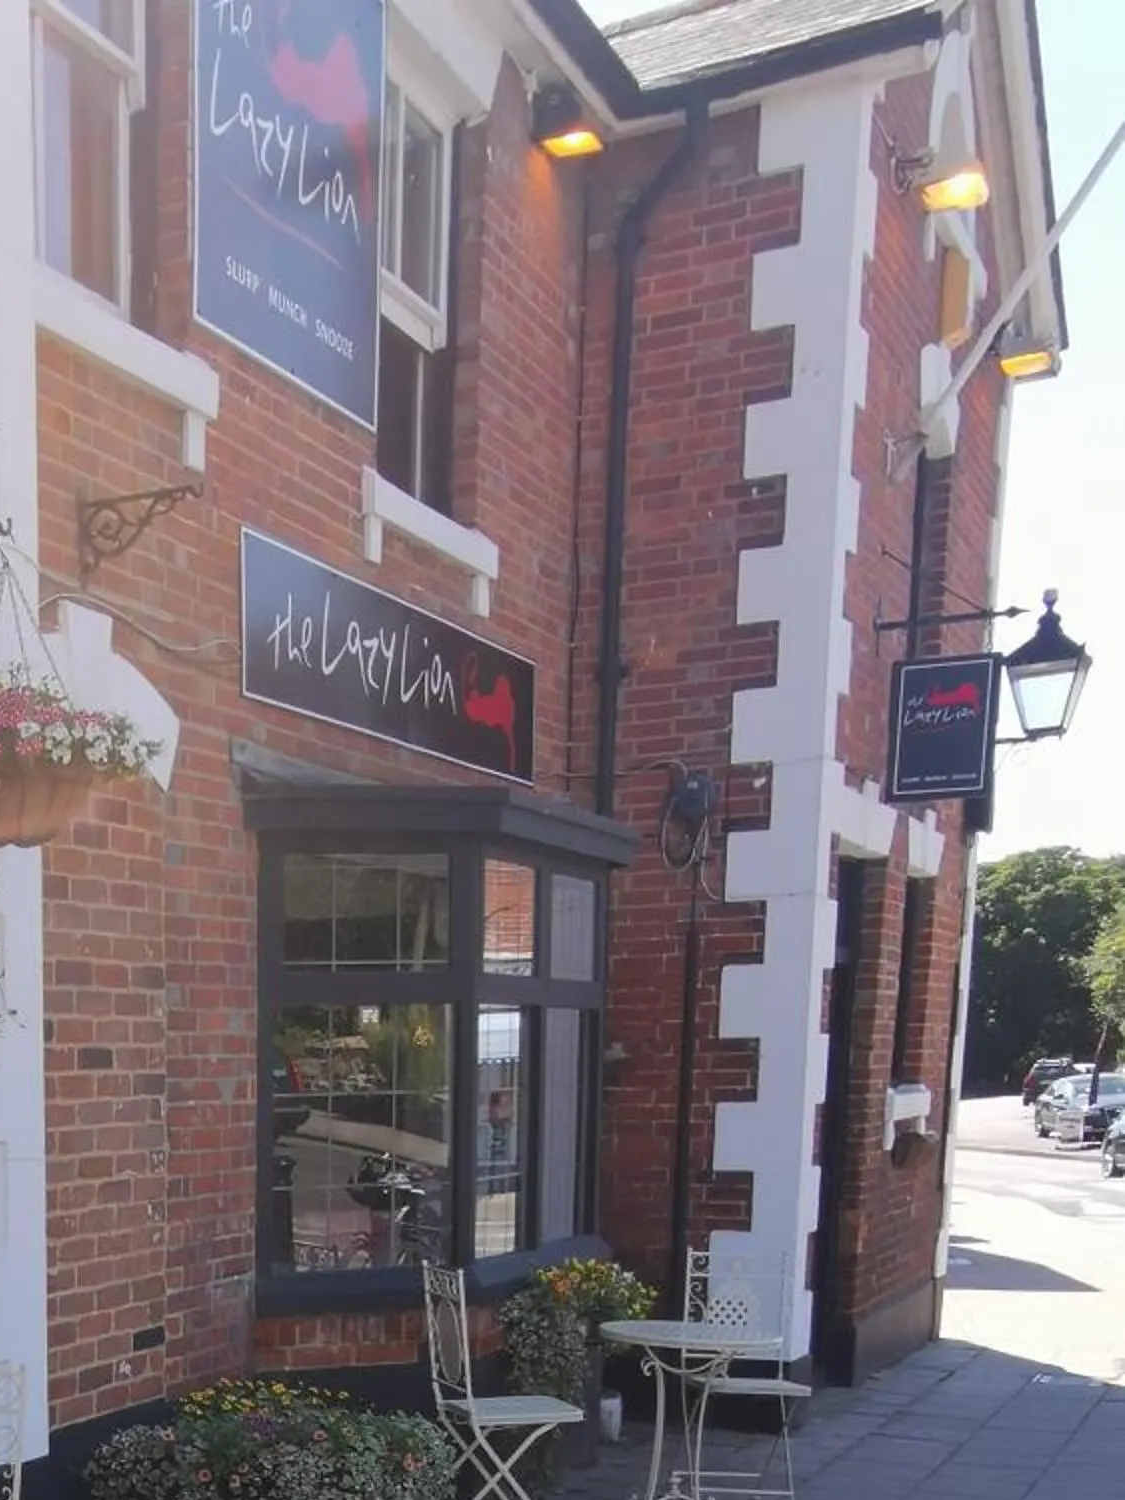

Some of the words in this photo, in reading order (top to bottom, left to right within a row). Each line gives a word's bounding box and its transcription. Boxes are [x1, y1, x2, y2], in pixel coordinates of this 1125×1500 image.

[210, 48, 294, 199] Lazy
[298, 123, 361, 245] Lion
[225, 255, 260, 295] SLURP
[268, 285, 308, 328] MUNCH
[314, 318, 355, 361] SNOOZE
[320, 591, 397, 706] Lazy
[400, 623, 458, 715] Lion
